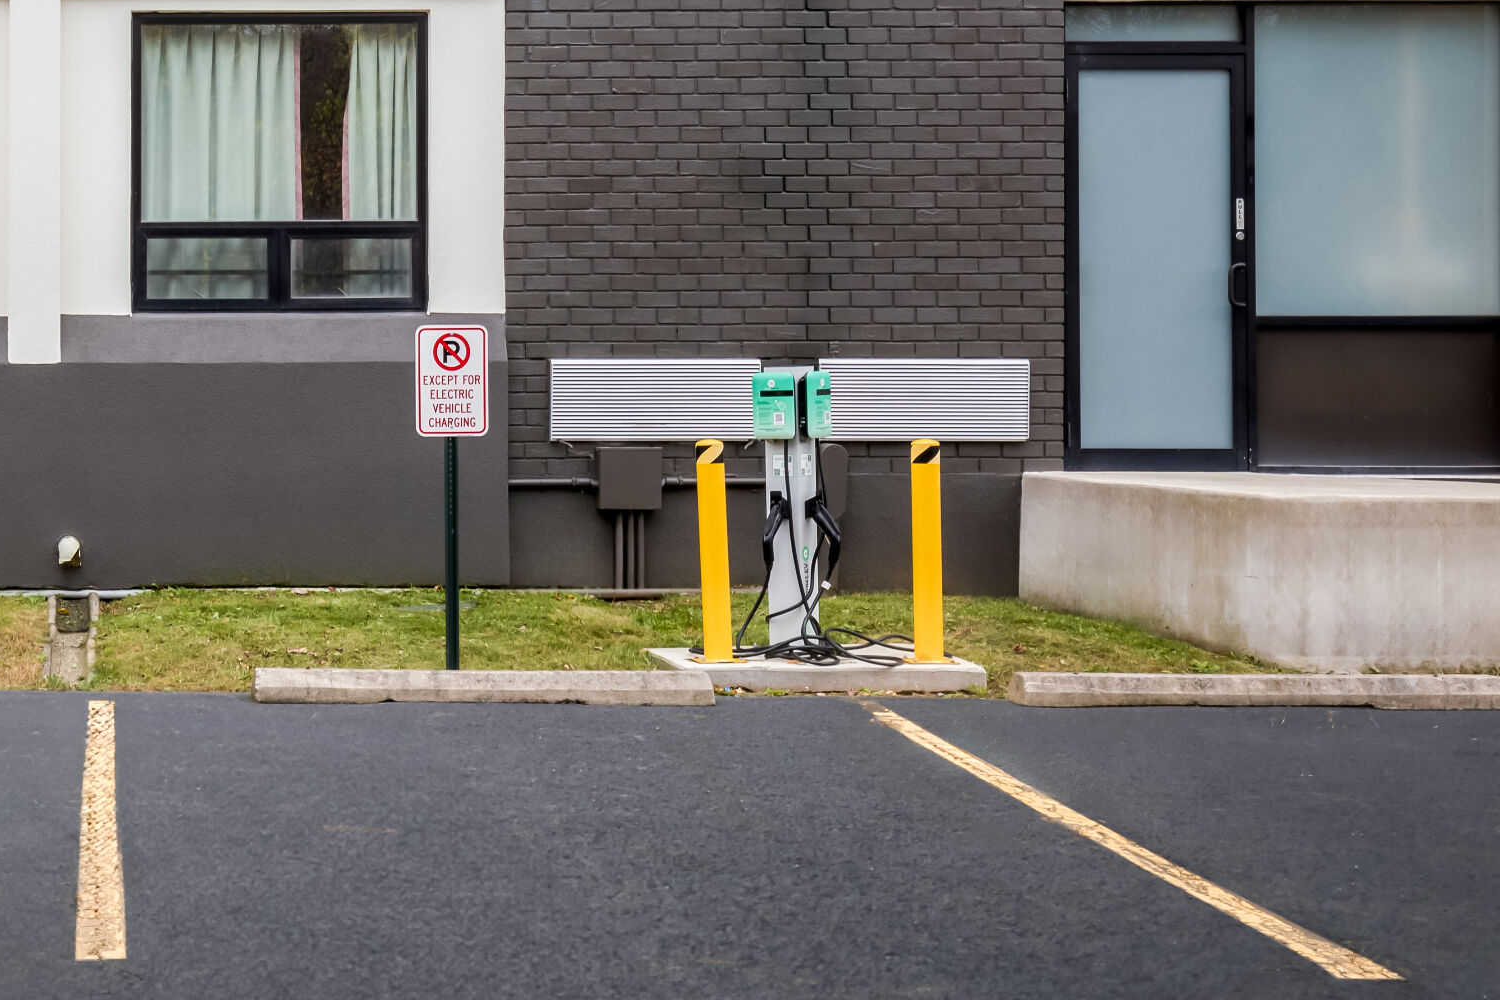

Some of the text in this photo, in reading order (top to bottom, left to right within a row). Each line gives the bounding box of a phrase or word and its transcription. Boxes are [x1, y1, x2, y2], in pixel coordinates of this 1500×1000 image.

[423, 374, 481, 386] EXCEPT FOR
[430, 389, 474, 399] ELECTRIC
[432, 403, 472, 413] VEHICLE
[428, 417, 476, 428] CHARGING
